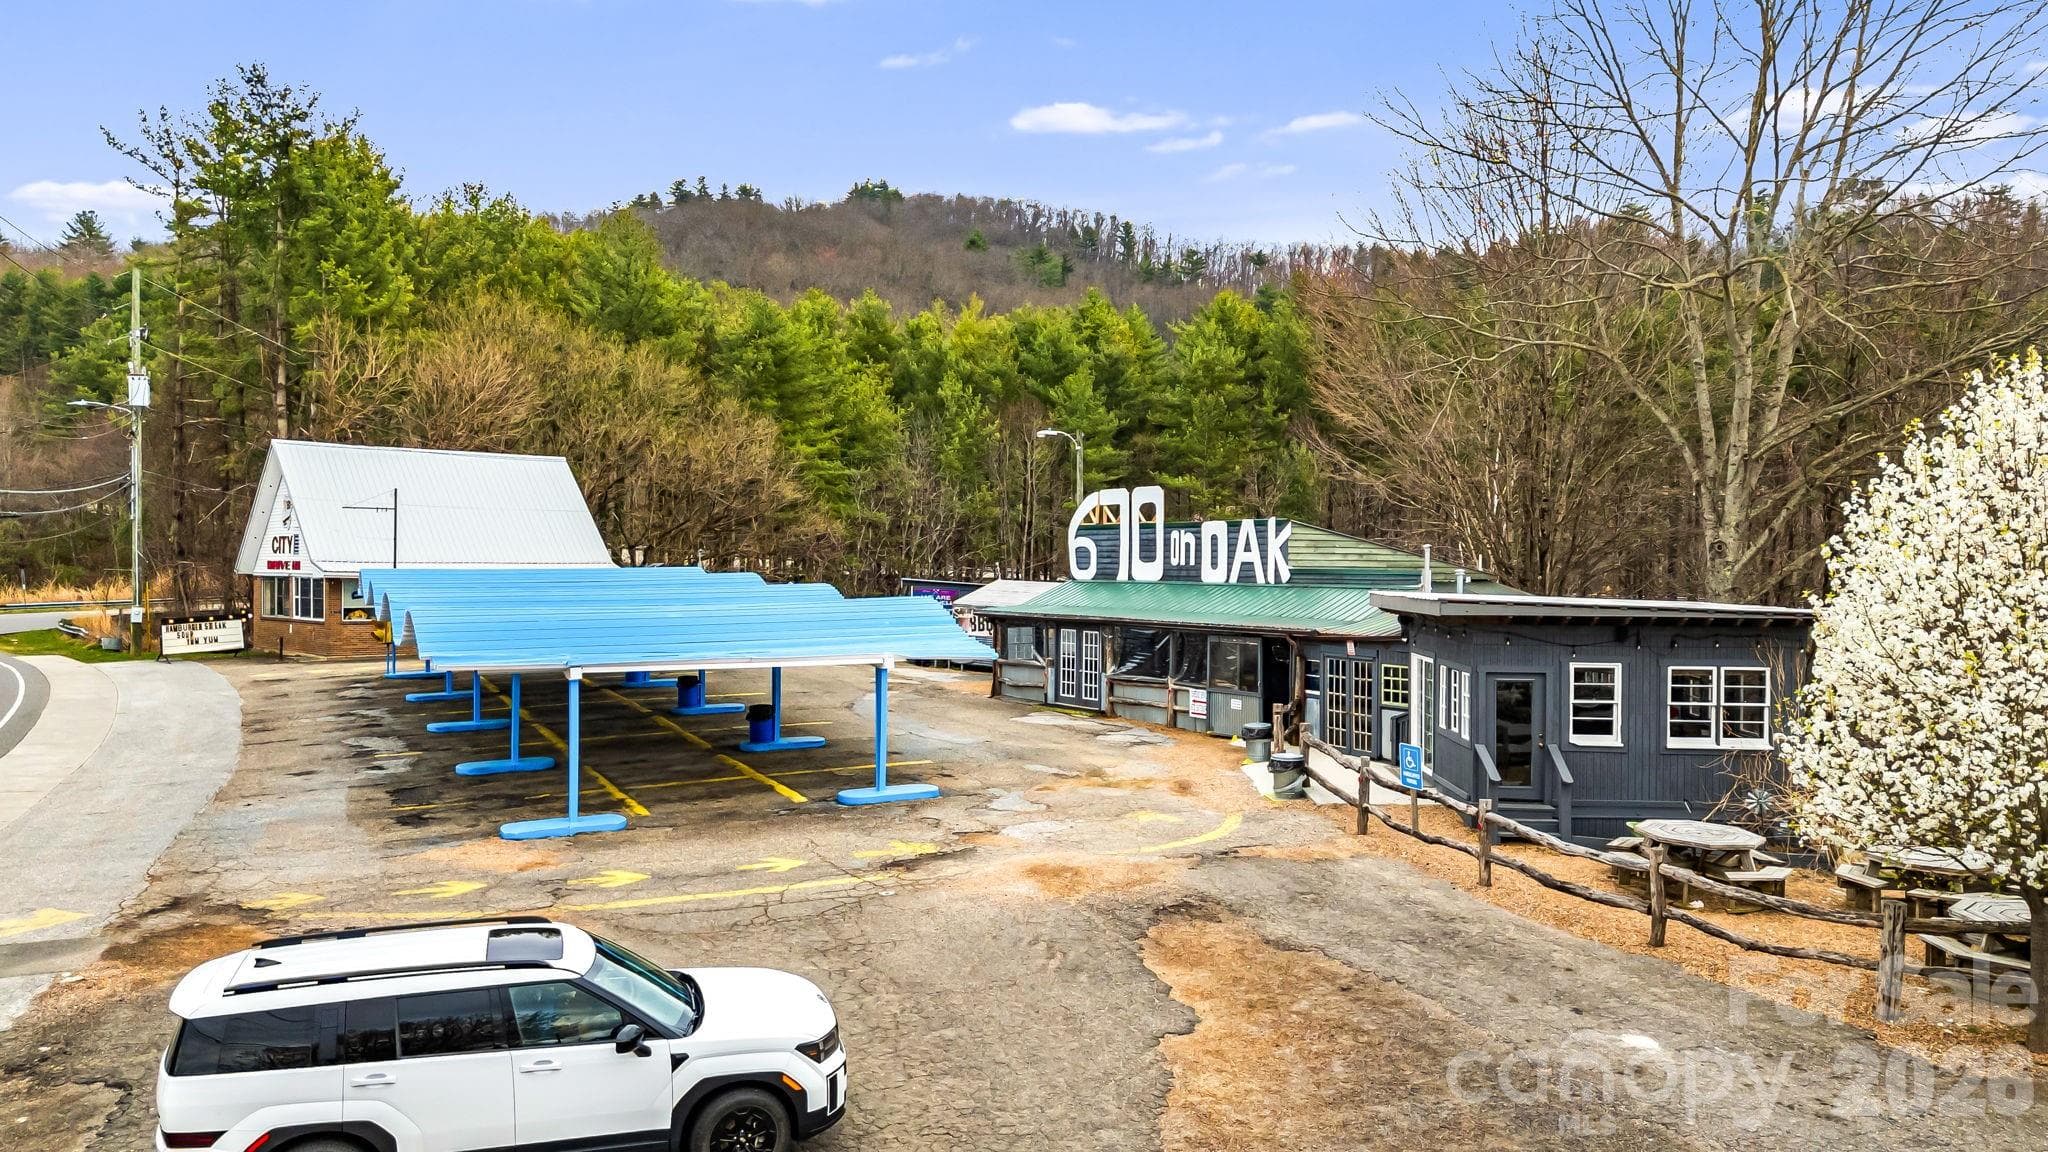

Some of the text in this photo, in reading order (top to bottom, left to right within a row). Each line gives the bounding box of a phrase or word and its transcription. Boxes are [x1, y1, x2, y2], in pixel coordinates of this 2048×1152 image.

[271, 535, 293, 554] CITY
[1170, 529, 1196, 566] on
[1201, 516, 1292, 584] OAK
